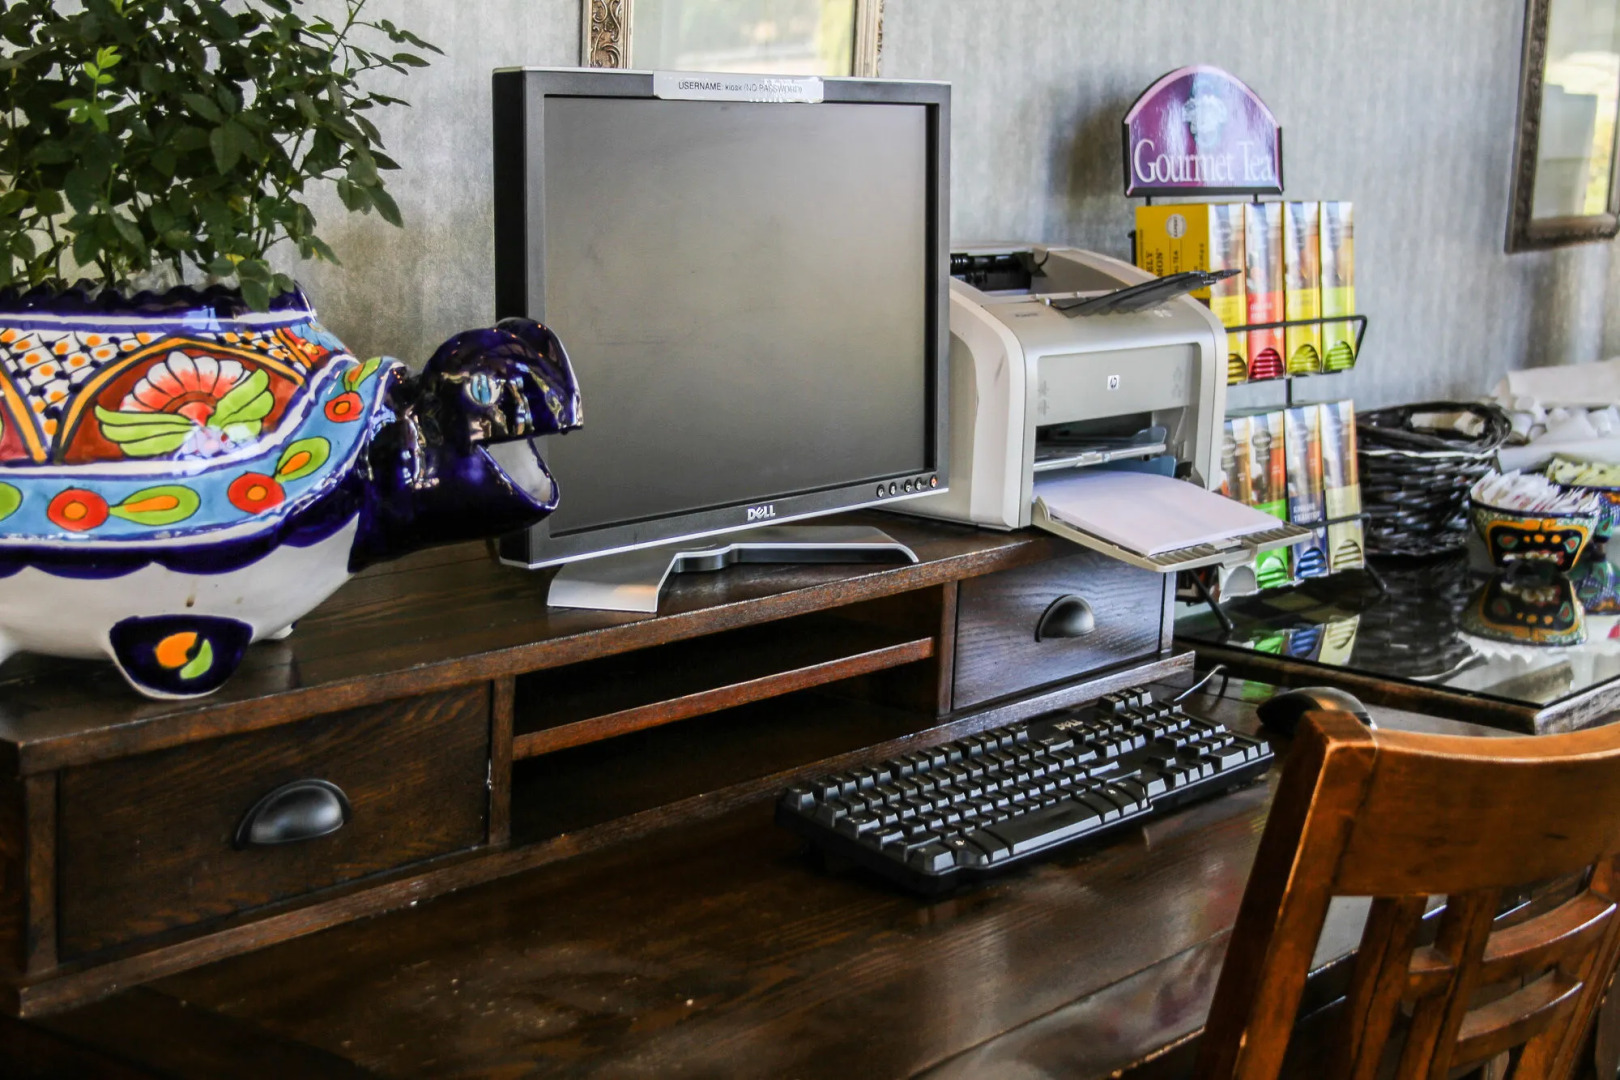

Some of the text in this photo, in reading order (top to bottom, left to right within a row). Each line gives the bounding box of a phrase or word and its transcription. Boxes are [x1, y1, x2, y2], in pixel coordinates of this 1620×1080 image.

[678, 81, 723, 91] USERNAME:
[1133, 138, 1273, 183] Gourmet Tea
[747, 505, 776, 521] DELL
